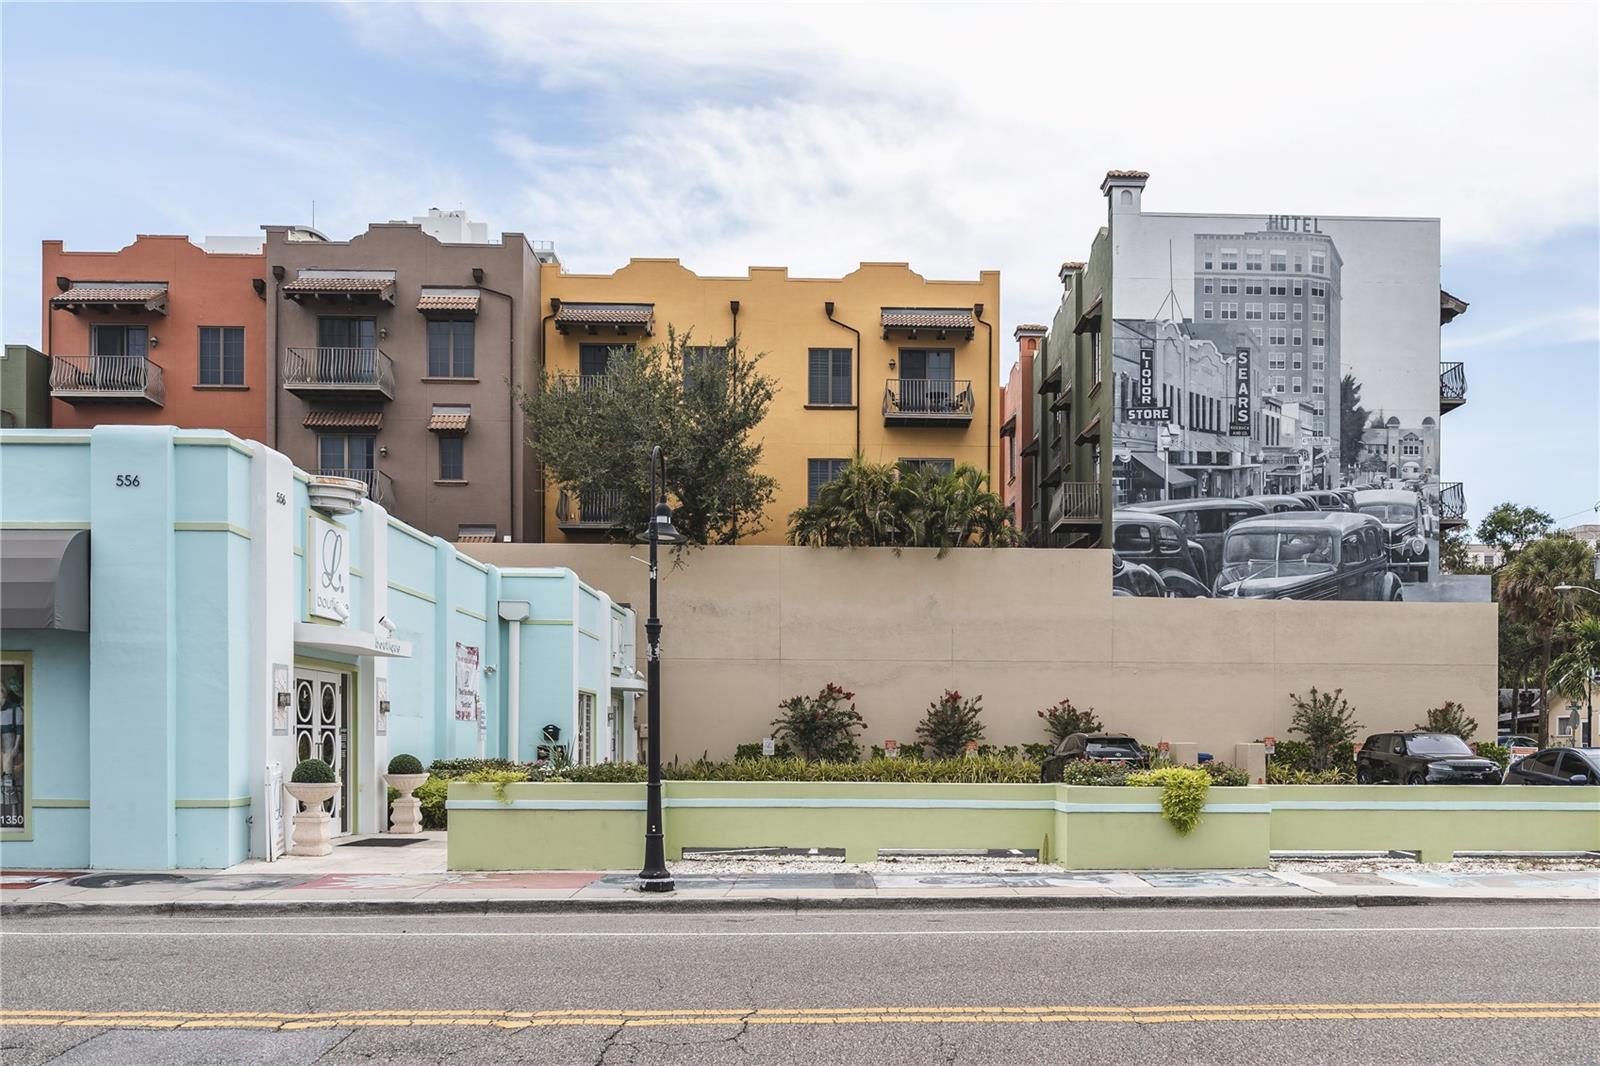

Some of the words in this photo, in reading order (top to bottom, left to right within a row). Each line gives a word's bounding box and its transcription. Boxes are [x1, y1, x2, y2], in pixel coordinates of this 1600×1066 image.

[1269, 215, 1322, 233] HOTEL
[1142, 351, 1151, 404] LIQUOR
[1238, 352, 1249, 422] SEARS
[1128, 409, 1169, 420] STORE
[116, 474, 140, 488] 556
